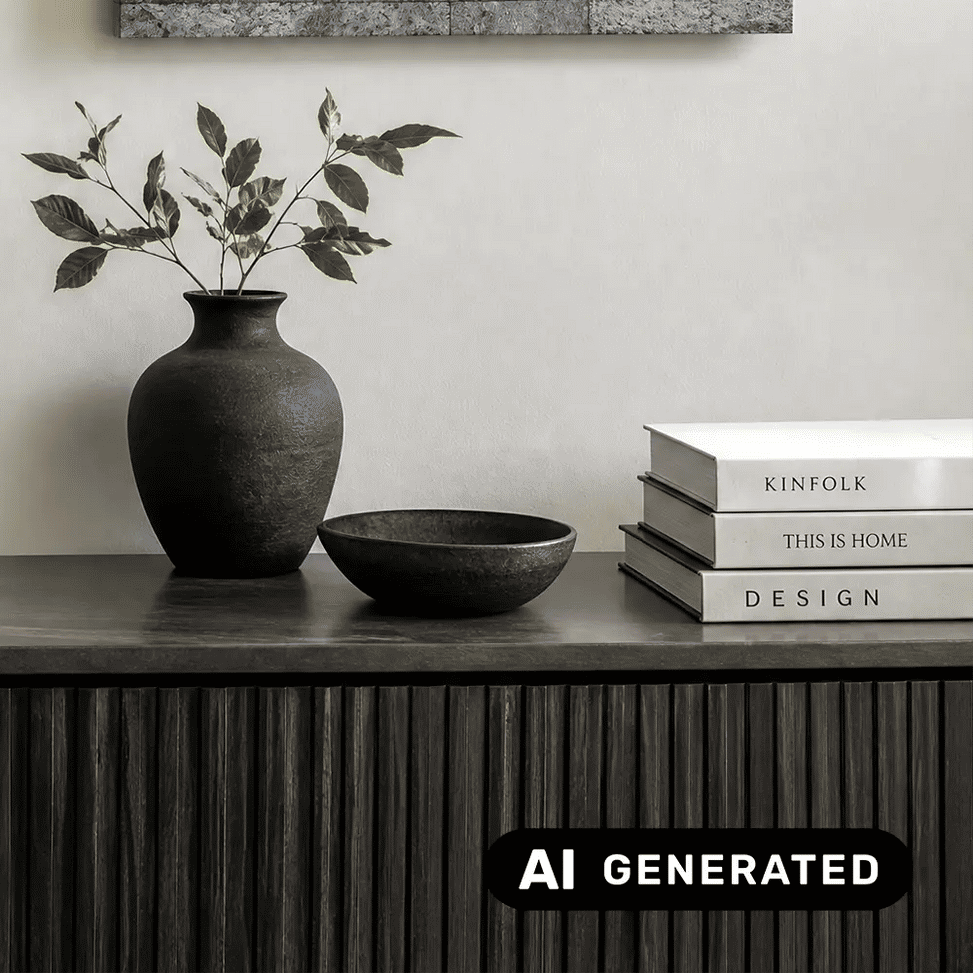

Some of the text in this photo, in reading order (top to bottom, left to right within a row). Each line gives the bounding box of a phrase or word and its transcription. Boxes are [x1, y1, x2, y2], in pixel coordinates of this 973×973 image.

[766, 477, 865, 491] KINFOLK
[783, 534, 907, 548] THIS IS HOME
[746, 590, 878, 607] DESIGN
